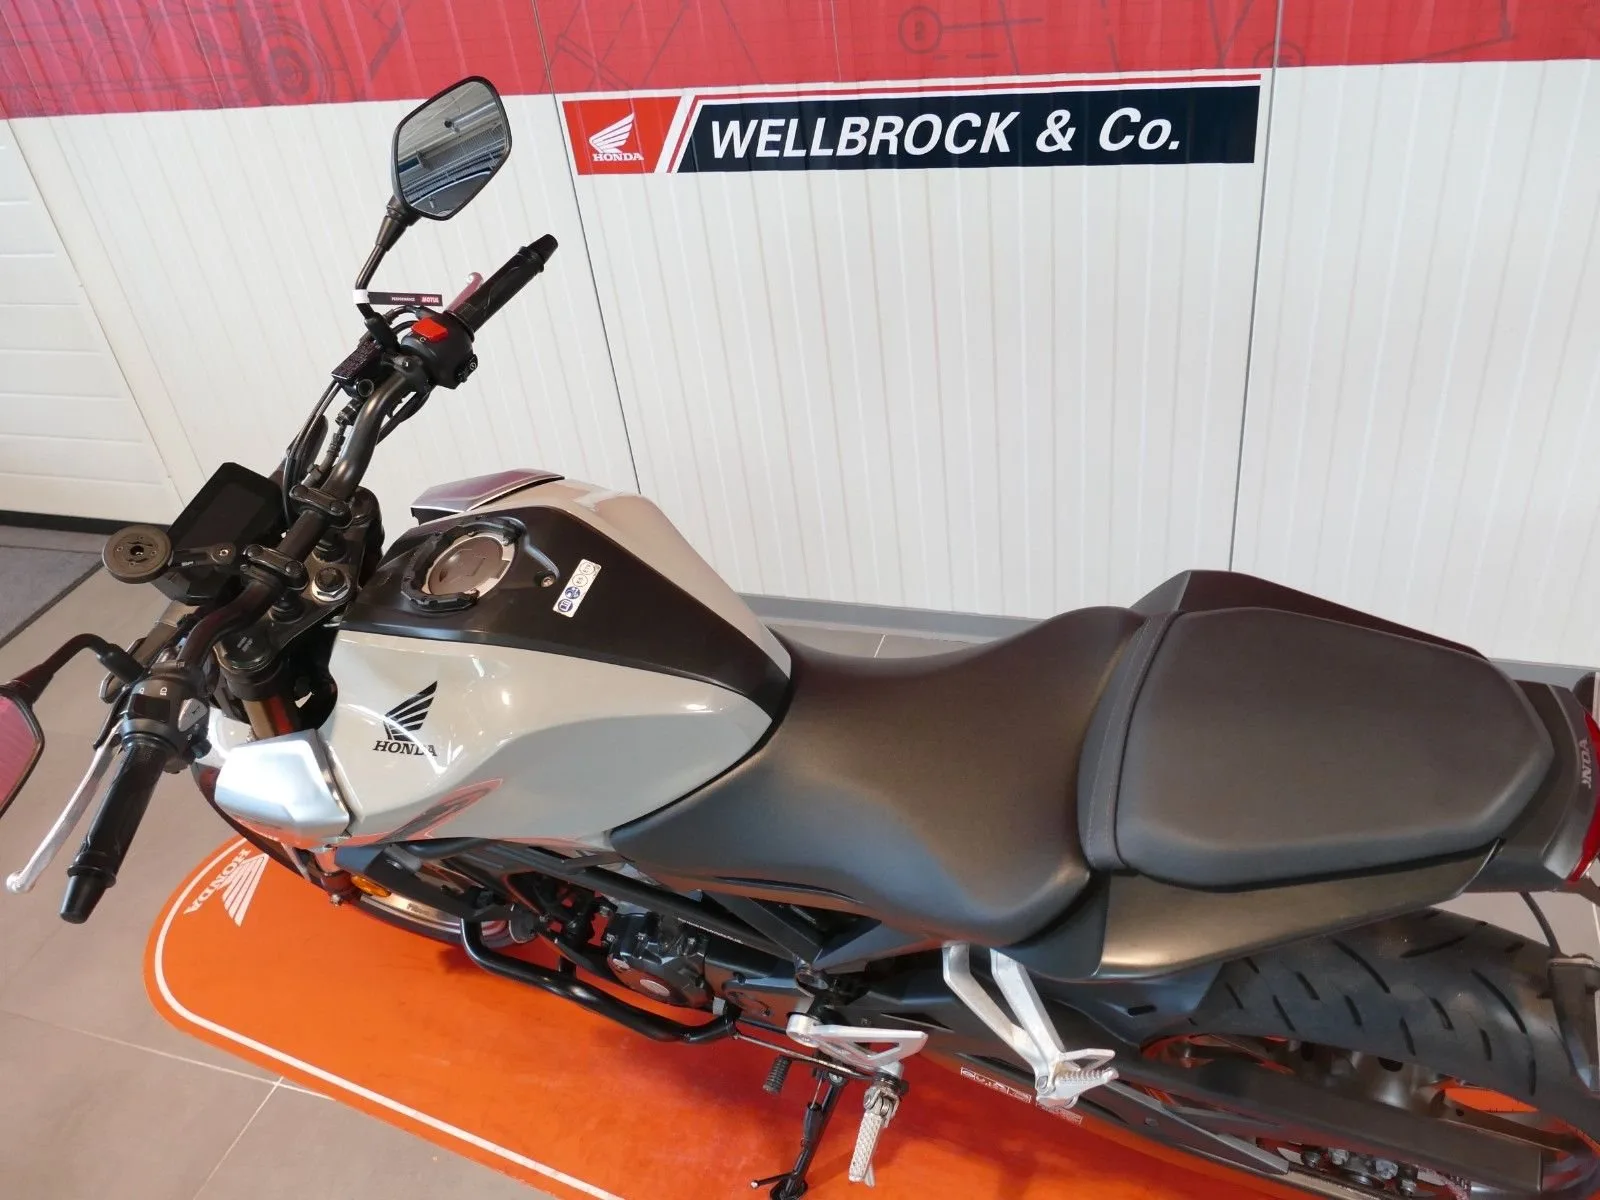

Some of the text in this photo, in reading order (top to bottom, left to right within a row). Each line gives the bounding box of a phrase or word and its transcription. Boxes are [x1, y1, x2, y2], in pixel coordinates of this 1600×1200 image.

[711, 107, 1180, 159] WELLBROCK & Co.
[592, 152, 645, 162] HONDA
[372, 740, 438, 757] HONDA
[183, 848, 252, 915] HONDA
